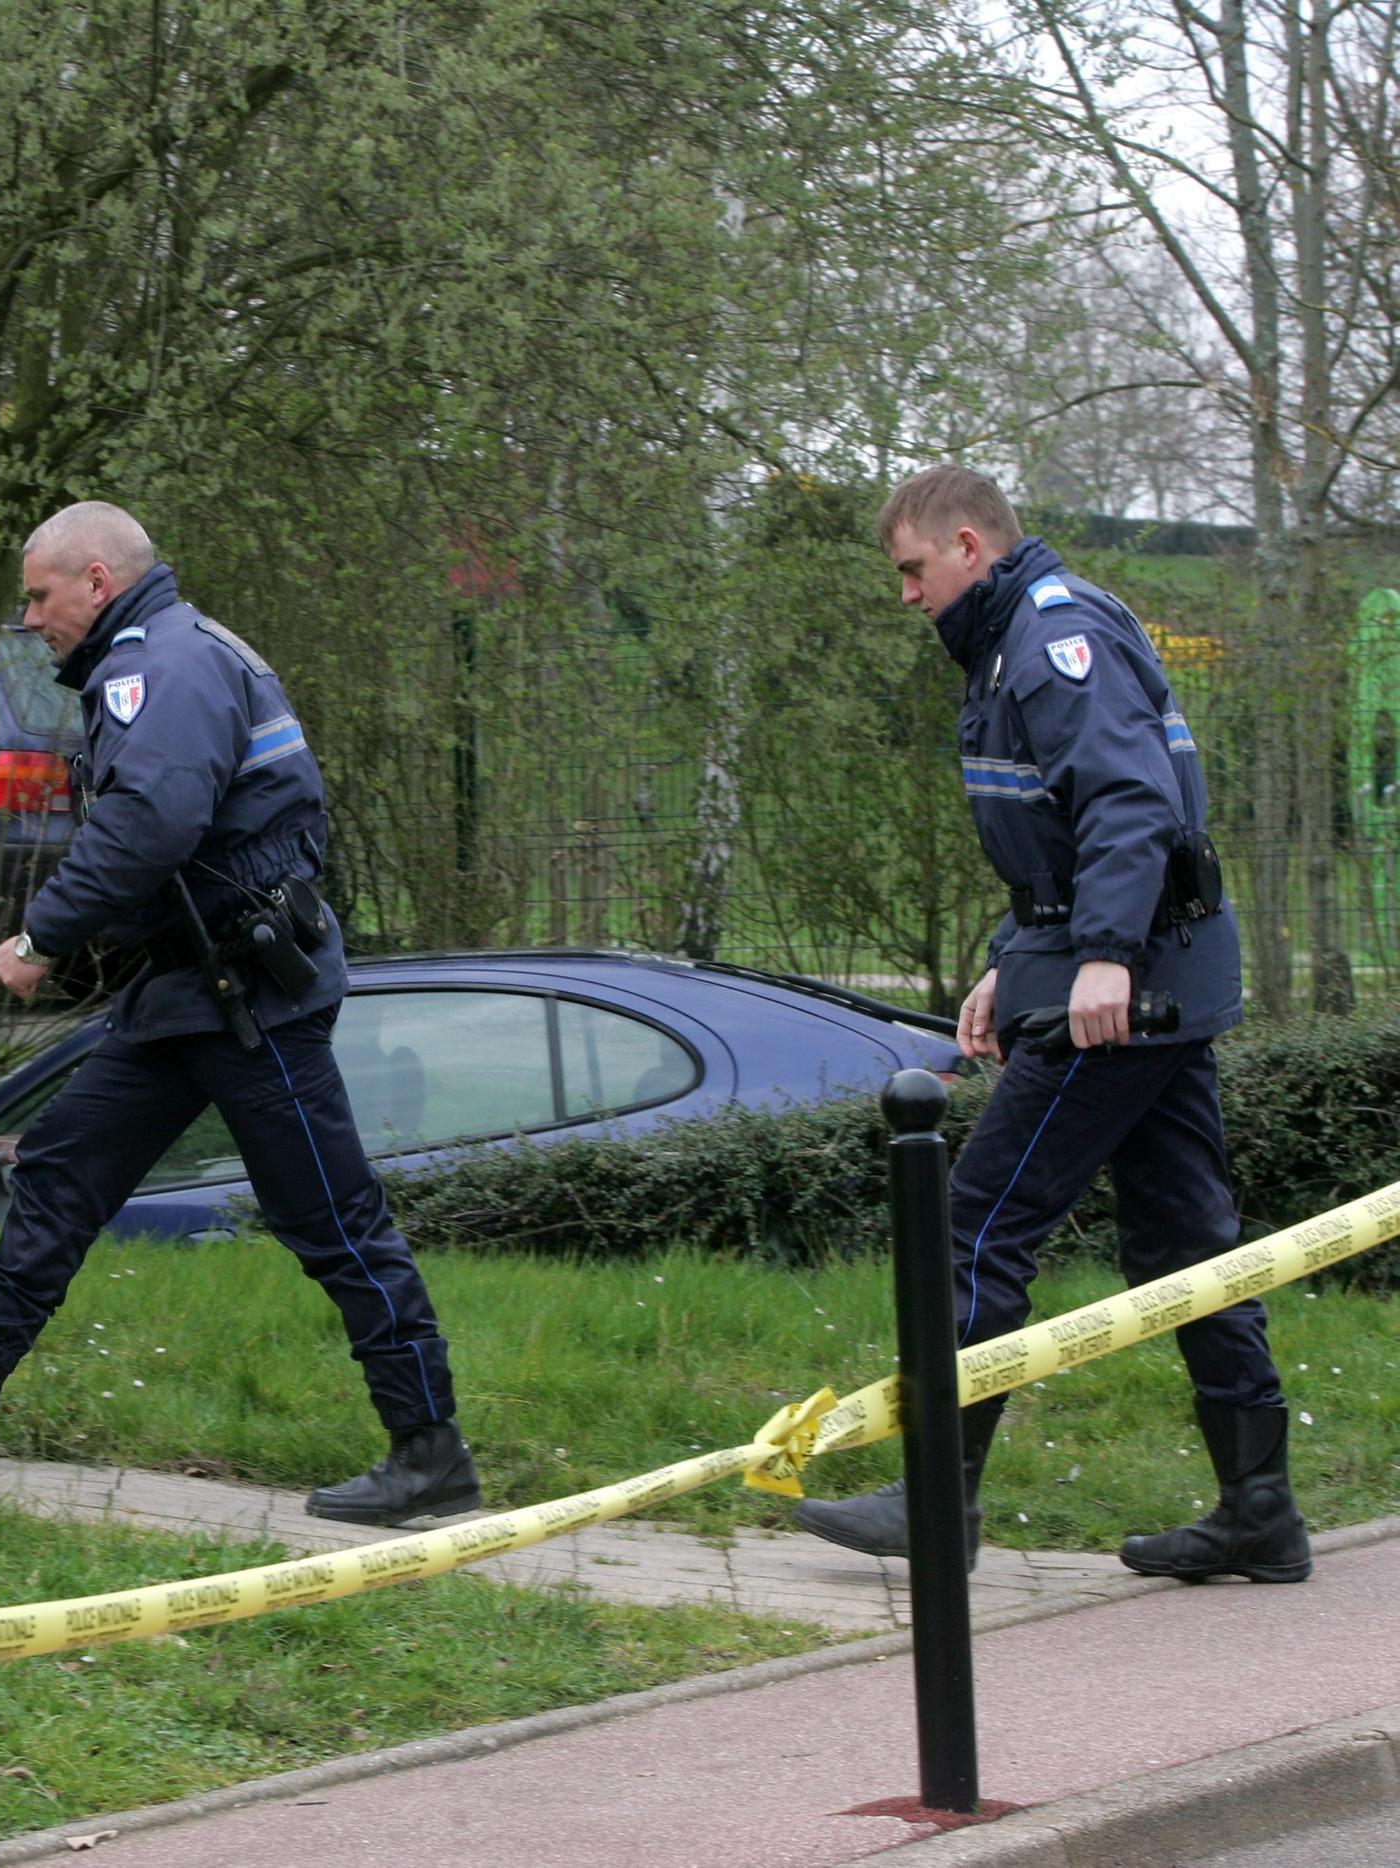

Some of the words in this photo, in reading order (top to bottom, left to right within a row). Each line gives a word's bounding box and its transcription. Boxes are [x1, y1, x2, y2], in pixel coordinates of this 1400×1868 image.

[1050, 637, 1084, 652] POLICE
[107, 676, 141, 690] POLICE
[1290, 1225, 1320, 1251] POLICE
[1316, 1213, 1354, 1242] NATIONALE
[1209, 1256, 1241, 1282] POLICE
[1239, 1245, 1277, 1273] NATIONALE
[1128, 1289, 1159, 1314] POLICE
[1158, 1277, 1195, 1304] NATIONALE
[1047, 1319, 1079, 1345] POLICE
[1078, 1306, 1115, 1335] NATIONALE
[960, 1350, 991, 1376] POLICE
[989, 1337, 1030, 1365] NATIONALE
